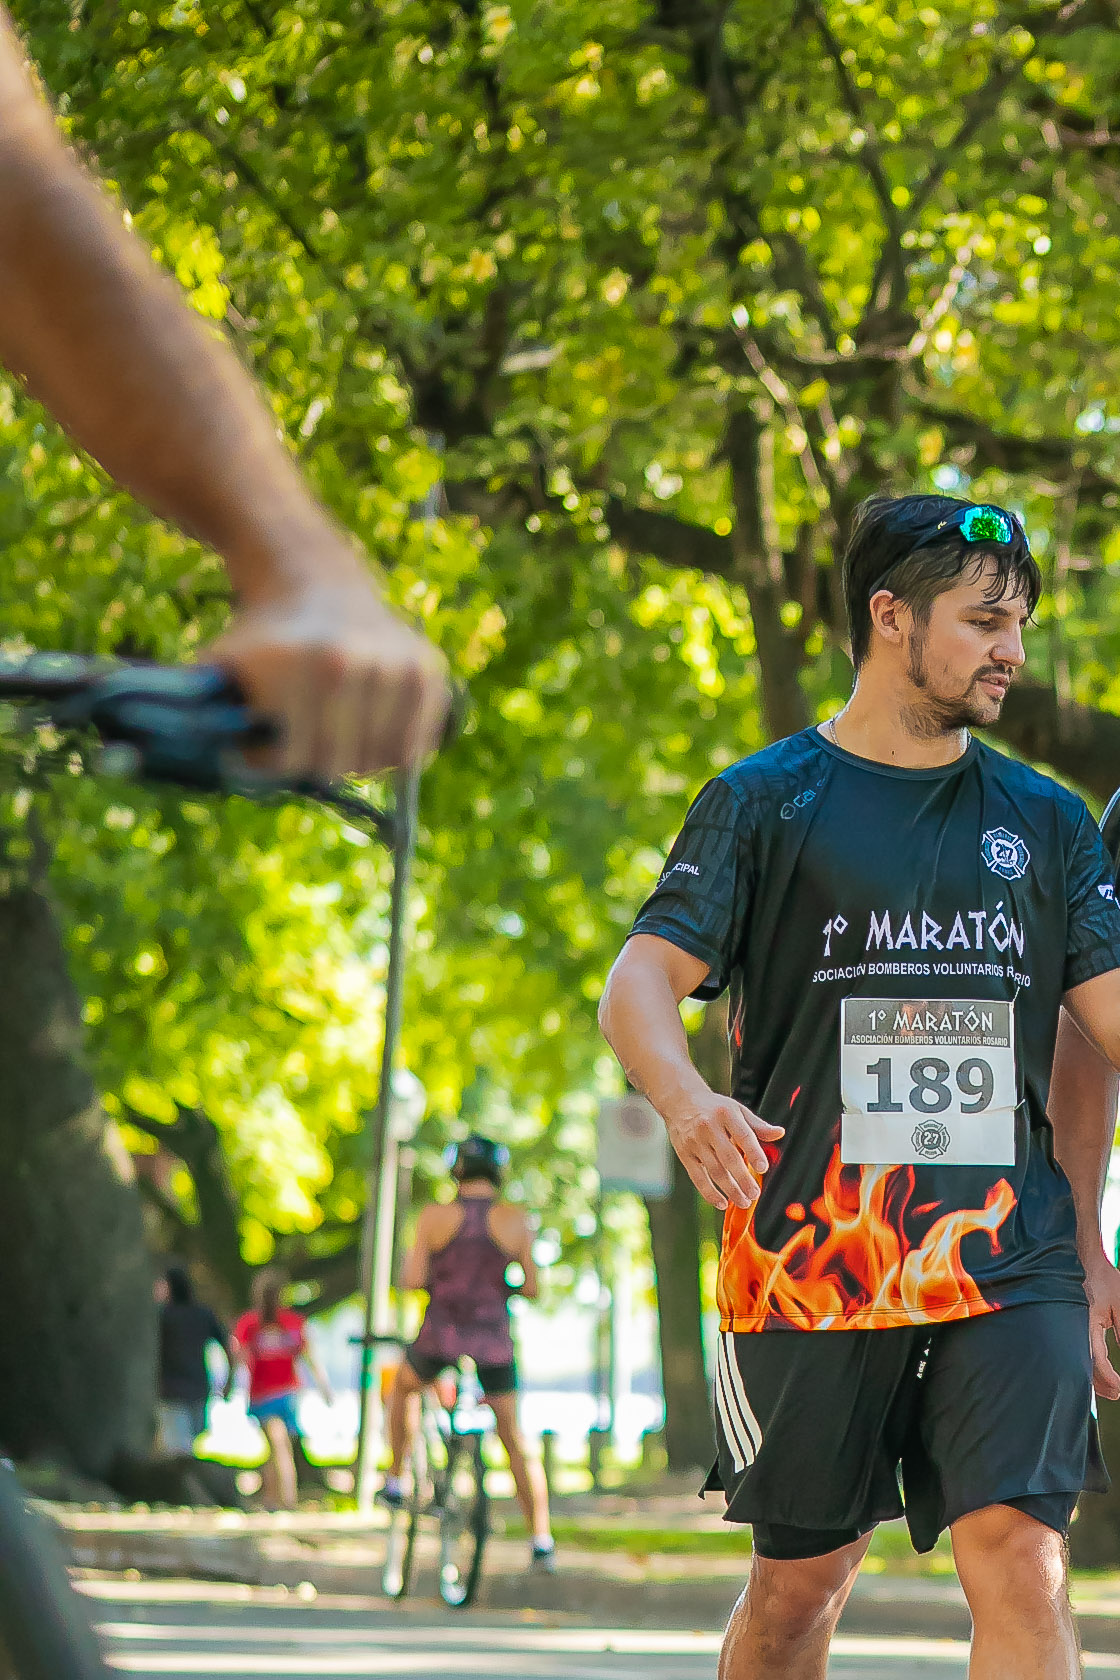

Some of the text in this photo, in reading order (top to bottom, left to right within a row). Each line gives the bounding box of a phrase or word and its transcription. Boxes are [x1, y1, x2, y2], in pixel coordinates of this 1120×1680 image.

[866, 901, 1025, 958] MARATÓN
[868, 962, 930, 976] BOMBEROS
[932, 962, 1004, 978] VOLUNTARIOS
[893, 1005, 993, 1032] MARATÓN
[851, 1033, 1008, 1047] ASOCIACIÓN BOMBEROS VOLUNTARIOS ROSARIO
[866, 1057, 994, 1114] 189
[923, 1131, 940, 1146] 27
